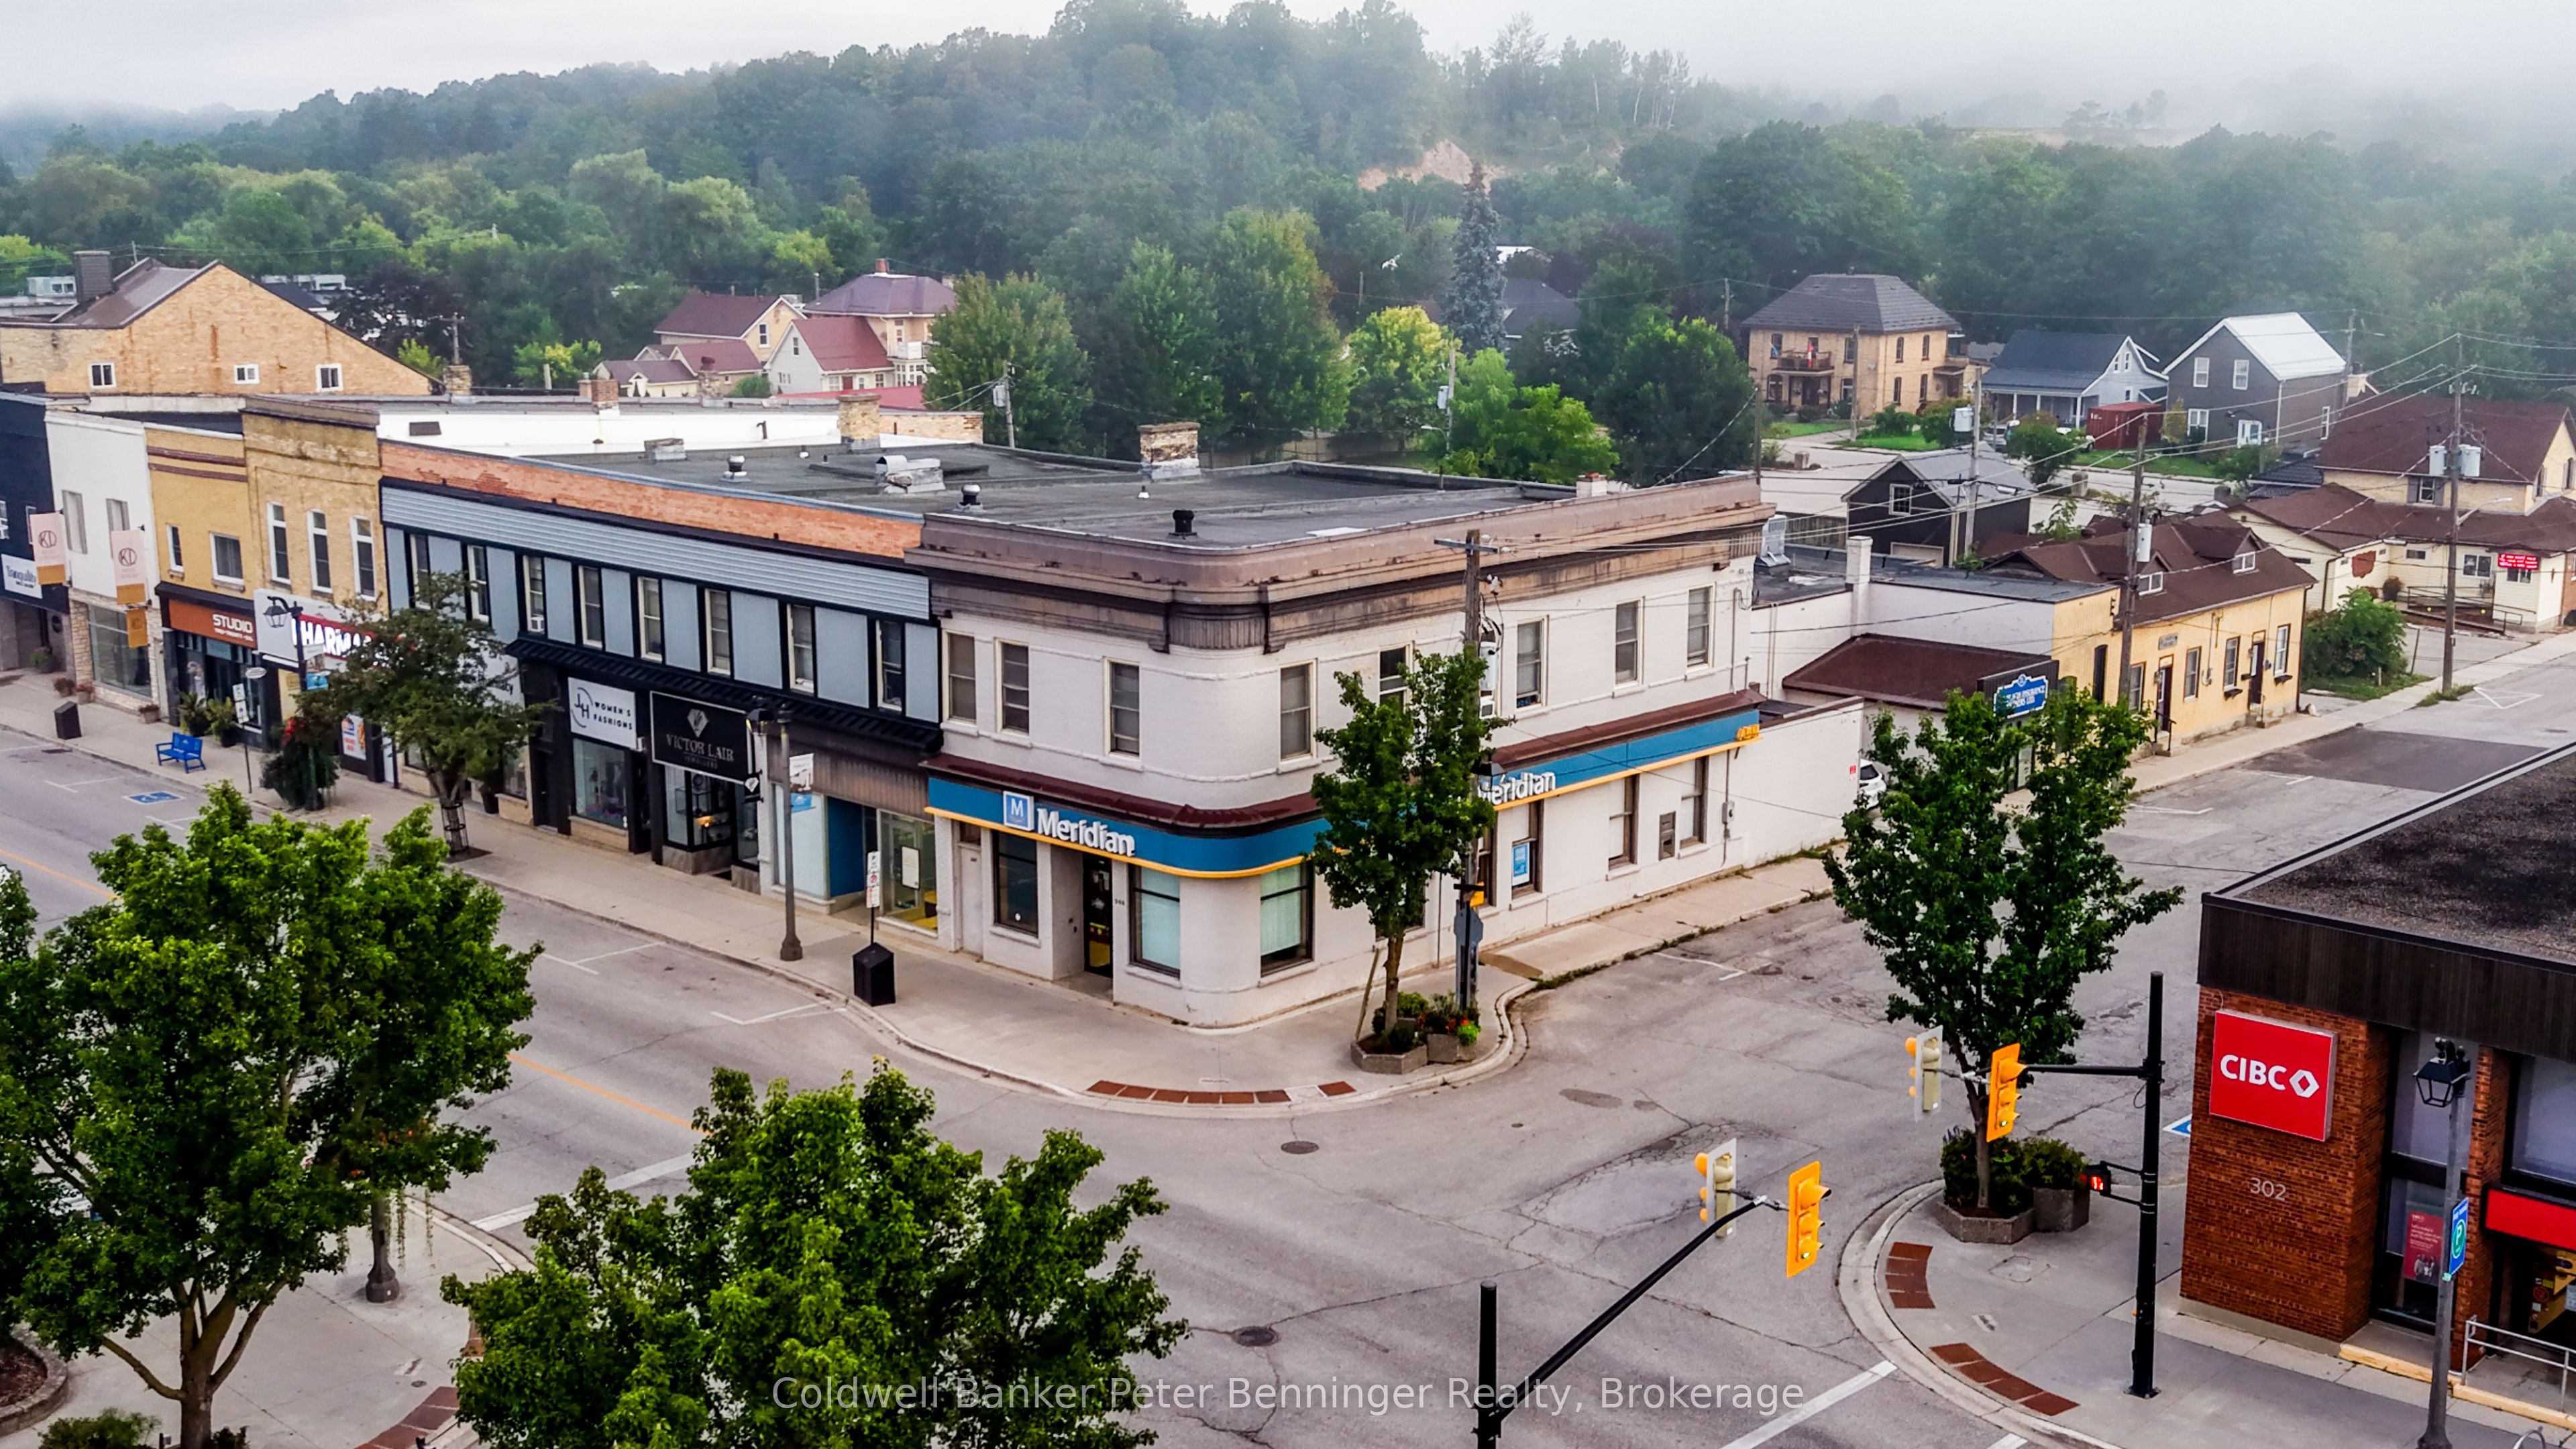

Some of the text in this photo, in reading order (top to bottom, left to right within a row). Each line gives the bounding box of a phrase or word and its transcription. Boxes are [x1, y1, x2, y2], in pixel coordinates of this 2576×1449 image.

[213, 614, 253, 634] STUDIO
[593, 713, 633, 731] FASHIONS
[666, 733, 735, 762] VICTOR LAIR
[1010, 798, 1024, 818] M
[1036, 808, 1135, 857] Meridian
[2220, 1054, 2288, 1091] CIBC
[2250, 1177, 2286, 1201] 302
